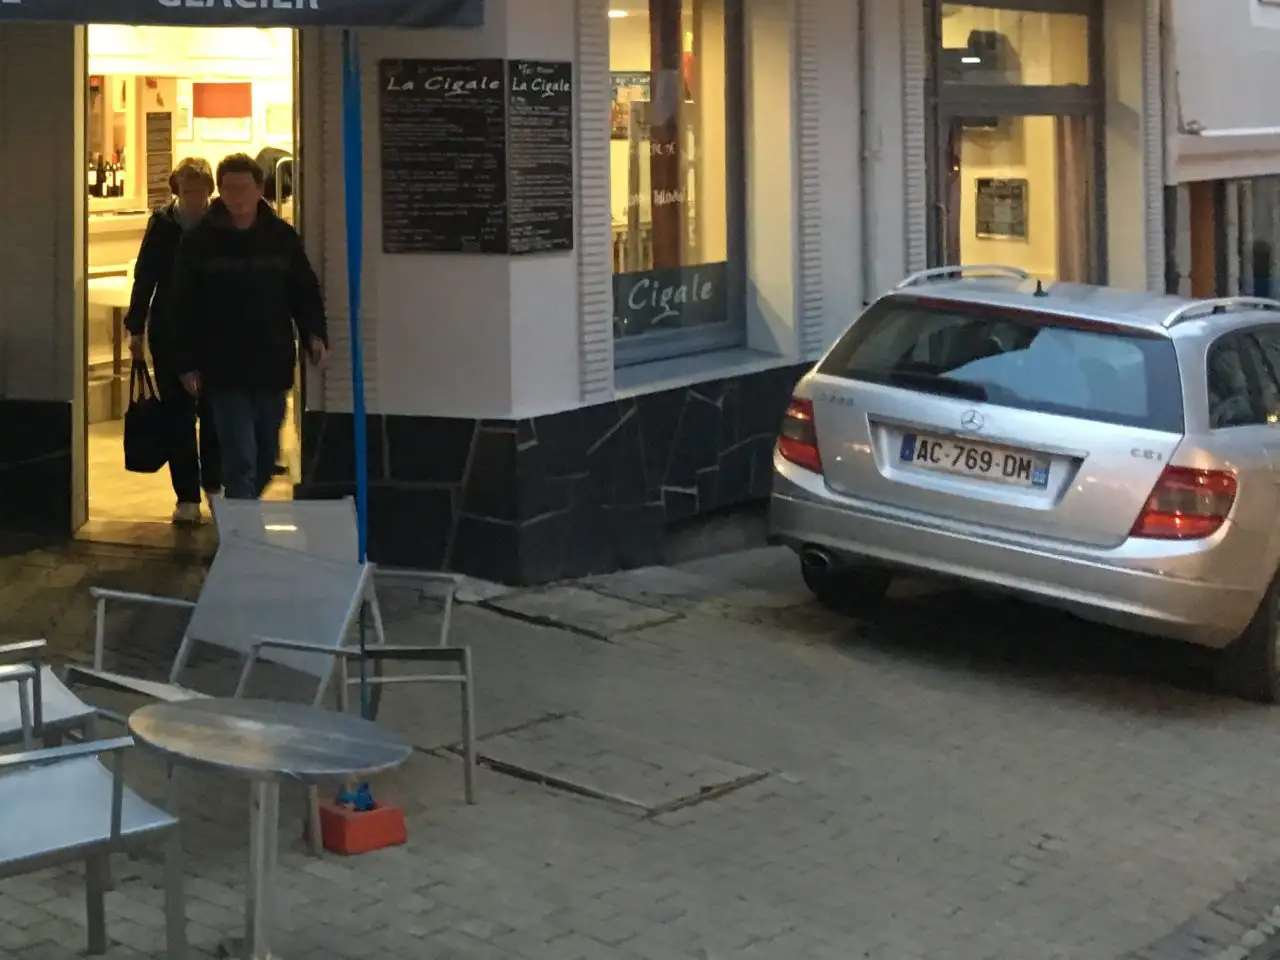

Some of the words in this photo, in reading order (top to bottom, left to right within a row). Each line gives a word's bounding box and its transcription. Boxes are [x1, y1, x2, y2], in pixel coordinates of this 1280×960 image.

[387, 76, 415, 91] La
[424, 76, 500, 97] Cigale
[512, 76, 527, 91] La
[531, 77, 570, 99] Cigale
[628, 273, 713, 325] Cigale
[915, 439, 1033, 481] AC-769-DM
